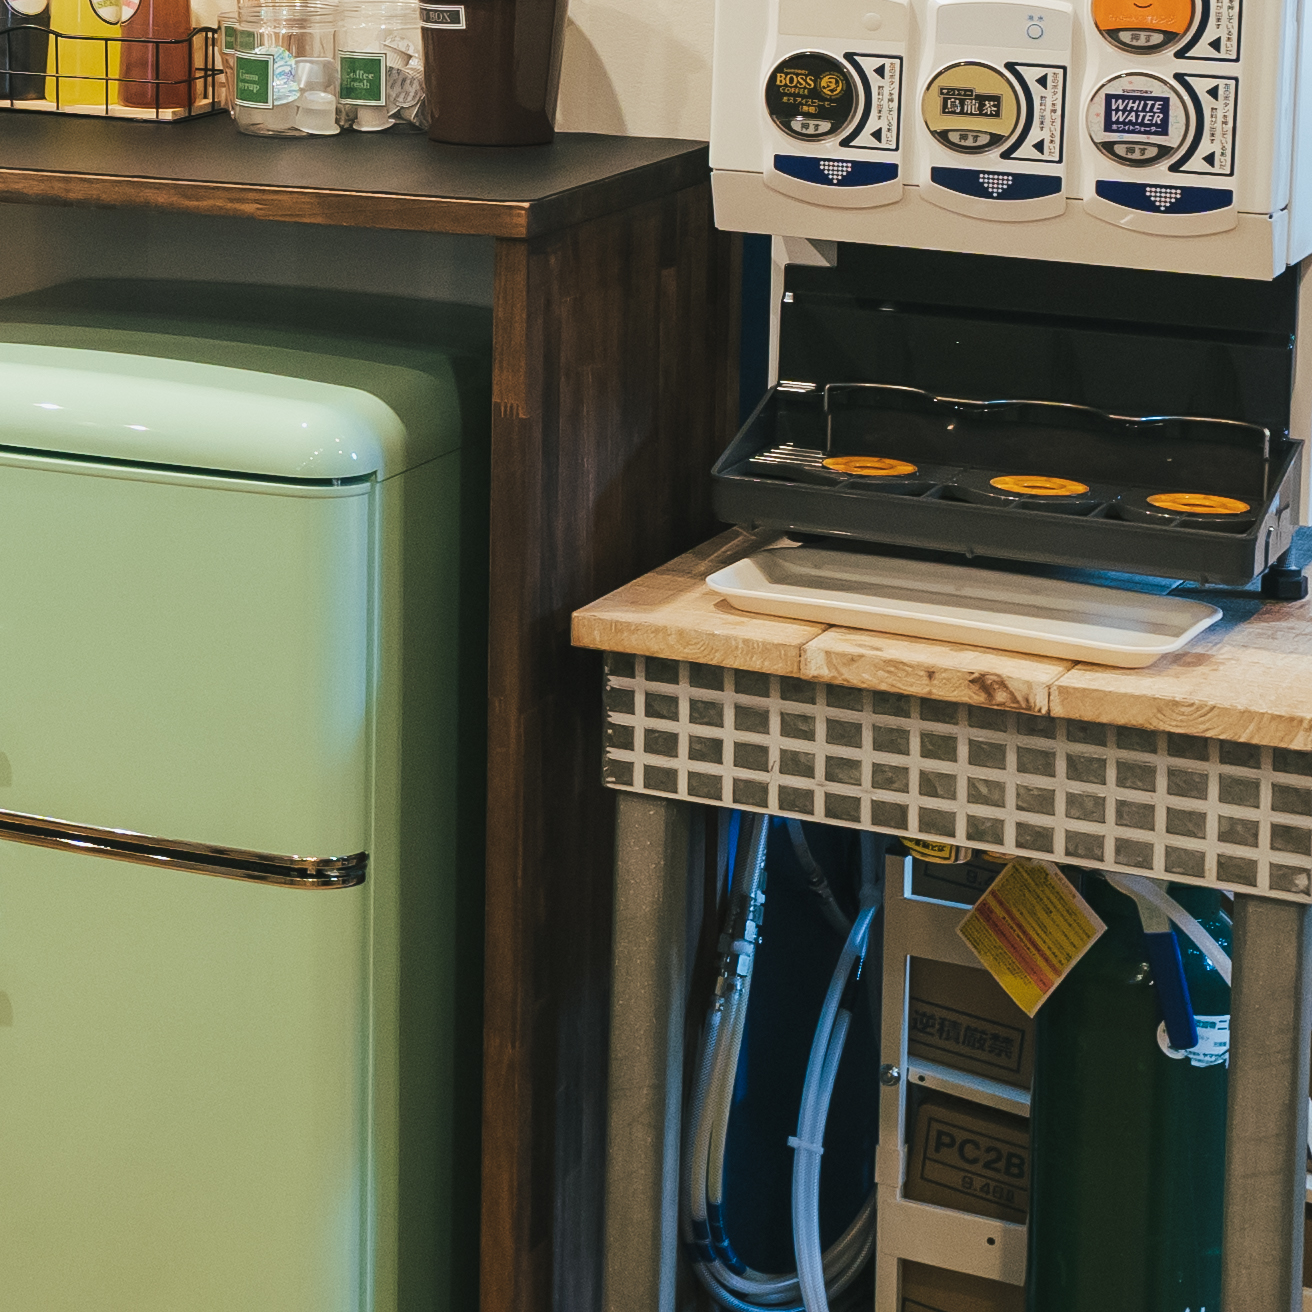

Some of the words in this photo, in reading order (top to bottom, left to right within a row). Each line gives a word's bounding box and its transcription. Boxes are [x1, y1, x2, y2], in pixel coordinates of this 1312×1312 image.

[430, 11, 451, 22] BOX
[1130, 33, 1153, 43] 押す
[776, 73, 815, 88] BOSS
[780, 87, 808, 95] COFFEE
[945, 98, 998, 115] 烏龍茶
[1111, 99, 1164, 112] WHITE
[1111, 111, 1164, 124] WATER
[800, 122, 821, 132] 押す
[1111, 124, 1162, 132] ホワイトウォーター
[958, 133, 981, 143] 押す
[1126, 146, 1147, 156] 押す
[934, 1129, 1027, 1180] PC2B
